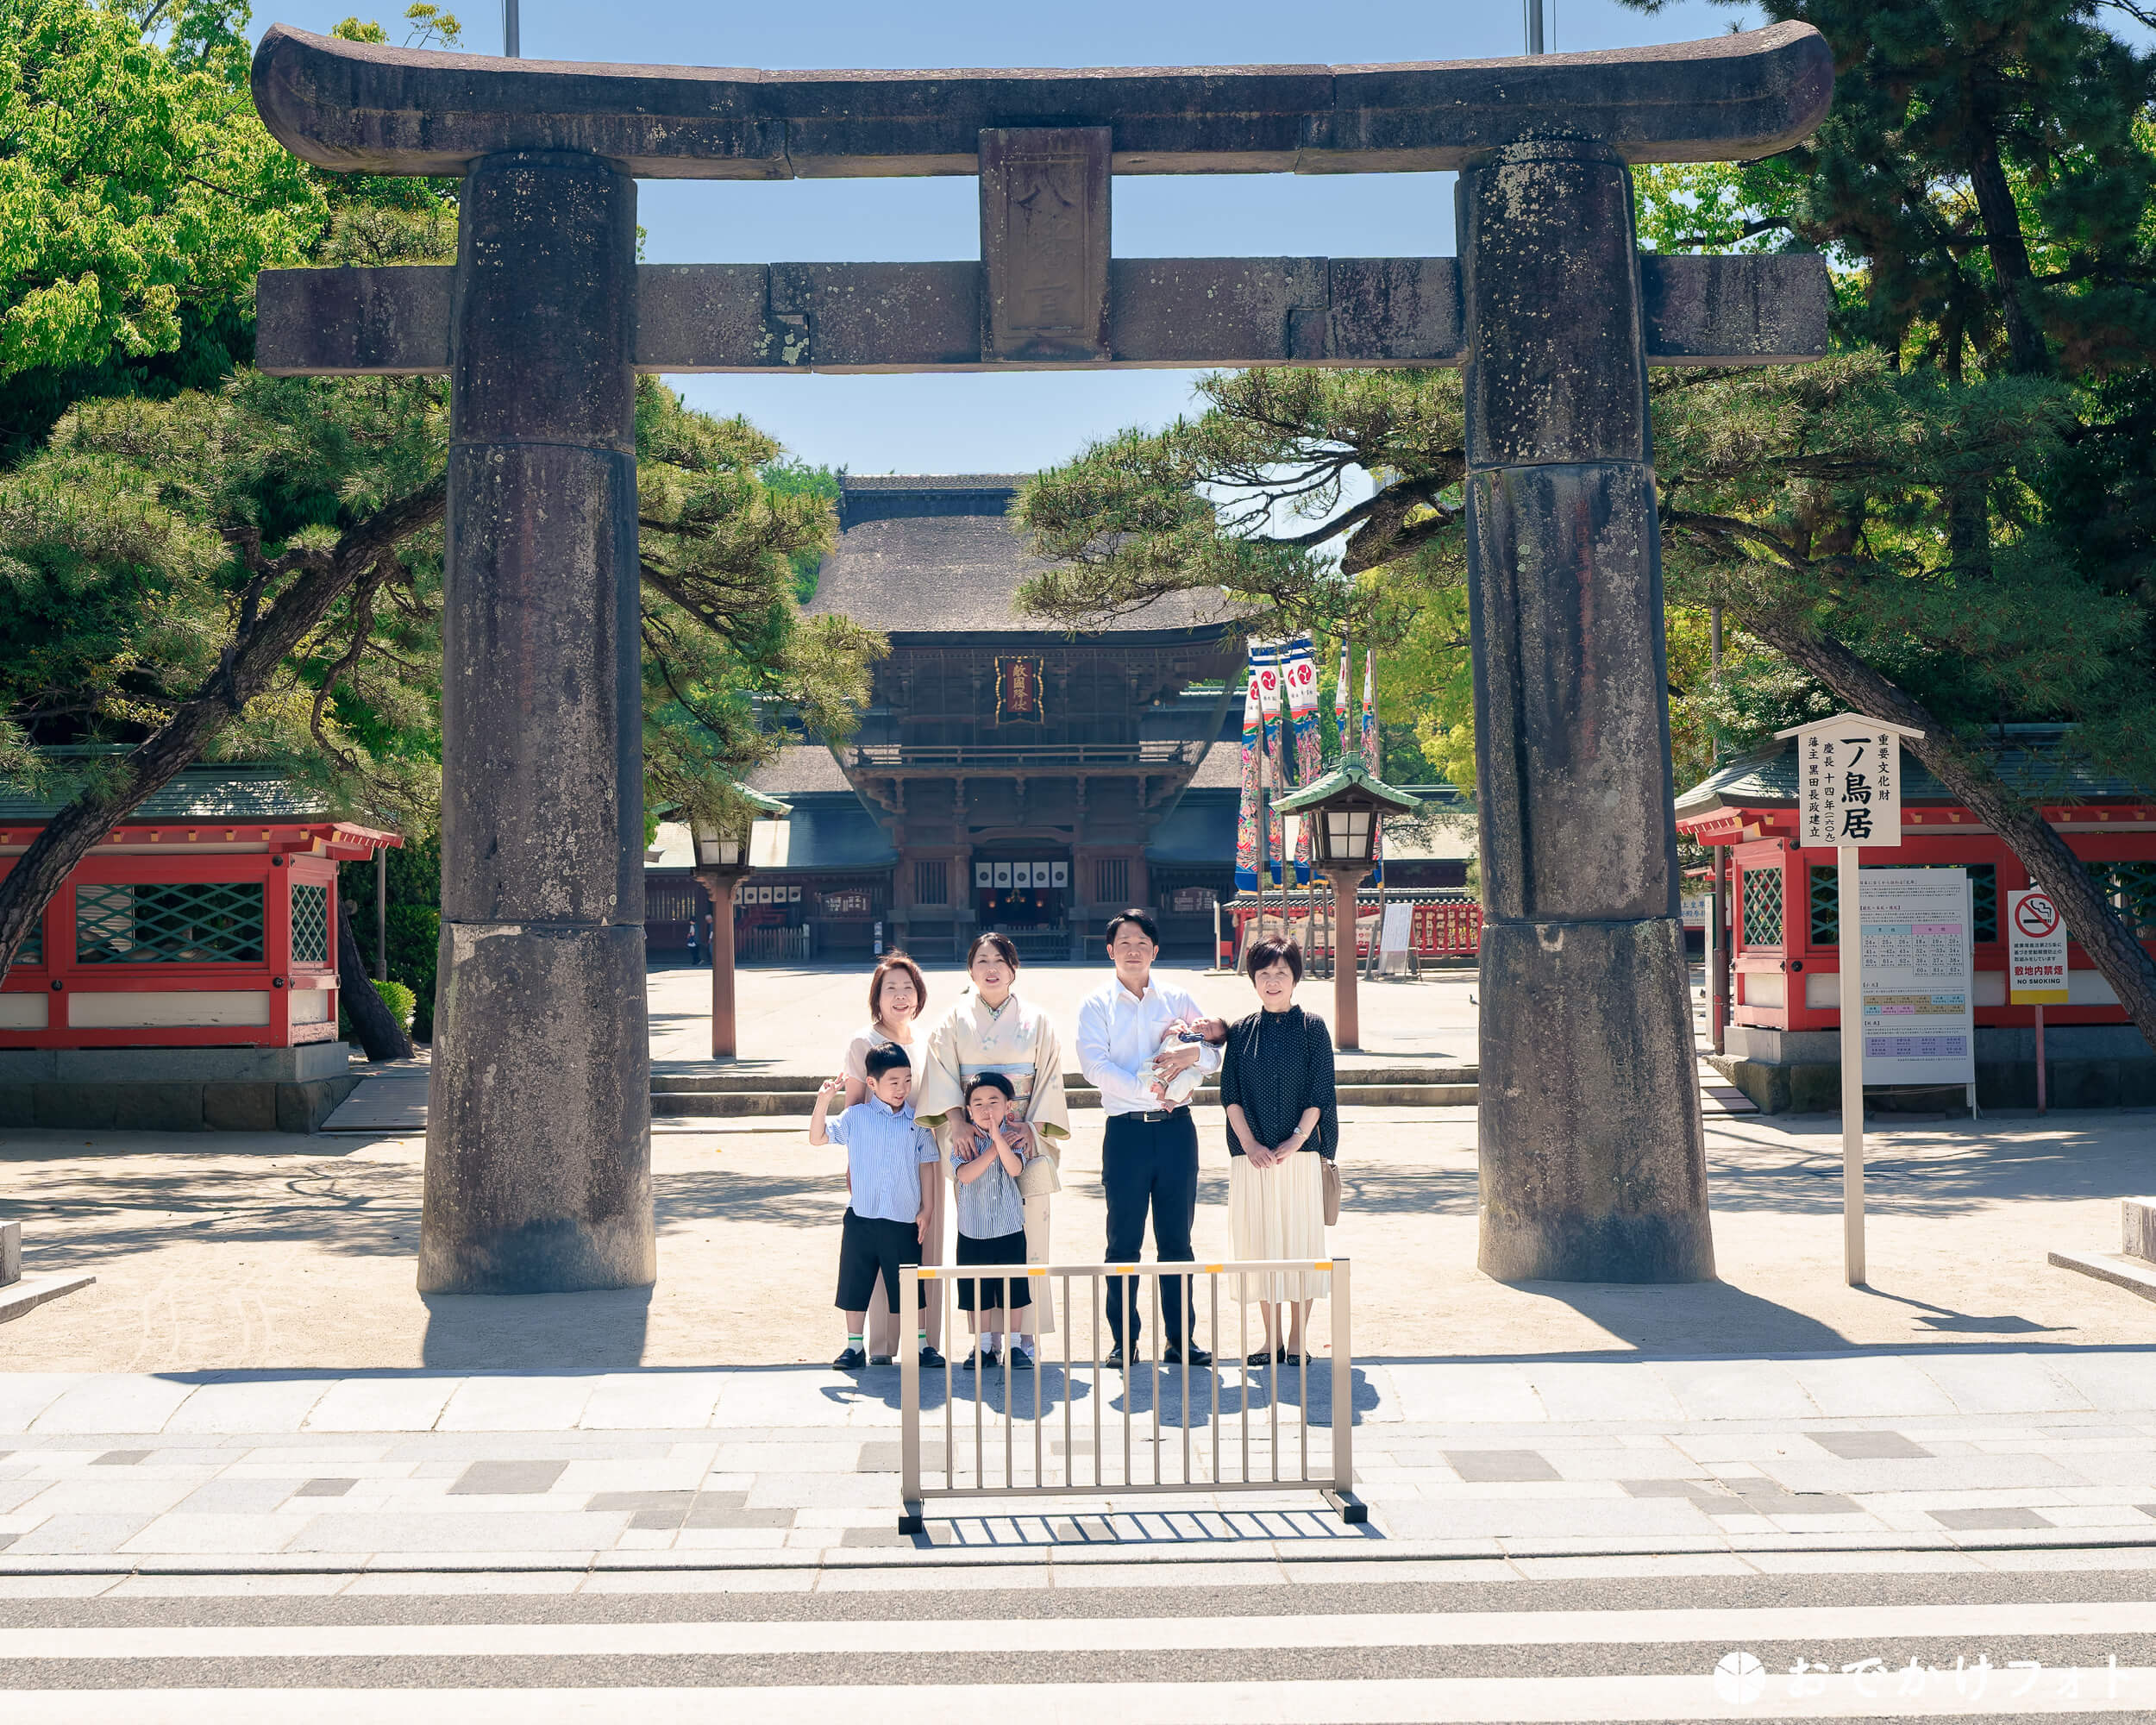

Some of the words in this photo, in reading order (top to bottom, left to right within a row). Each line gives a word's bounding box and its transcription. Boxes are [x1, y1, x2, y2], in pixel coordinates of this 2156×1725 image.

[1839, 737, 1873, 840] 一ノ鳥居
[1877, 733, 1890, 801] 重要文化財
[2015, 966, 2063, 975] 敷地内禁煙
